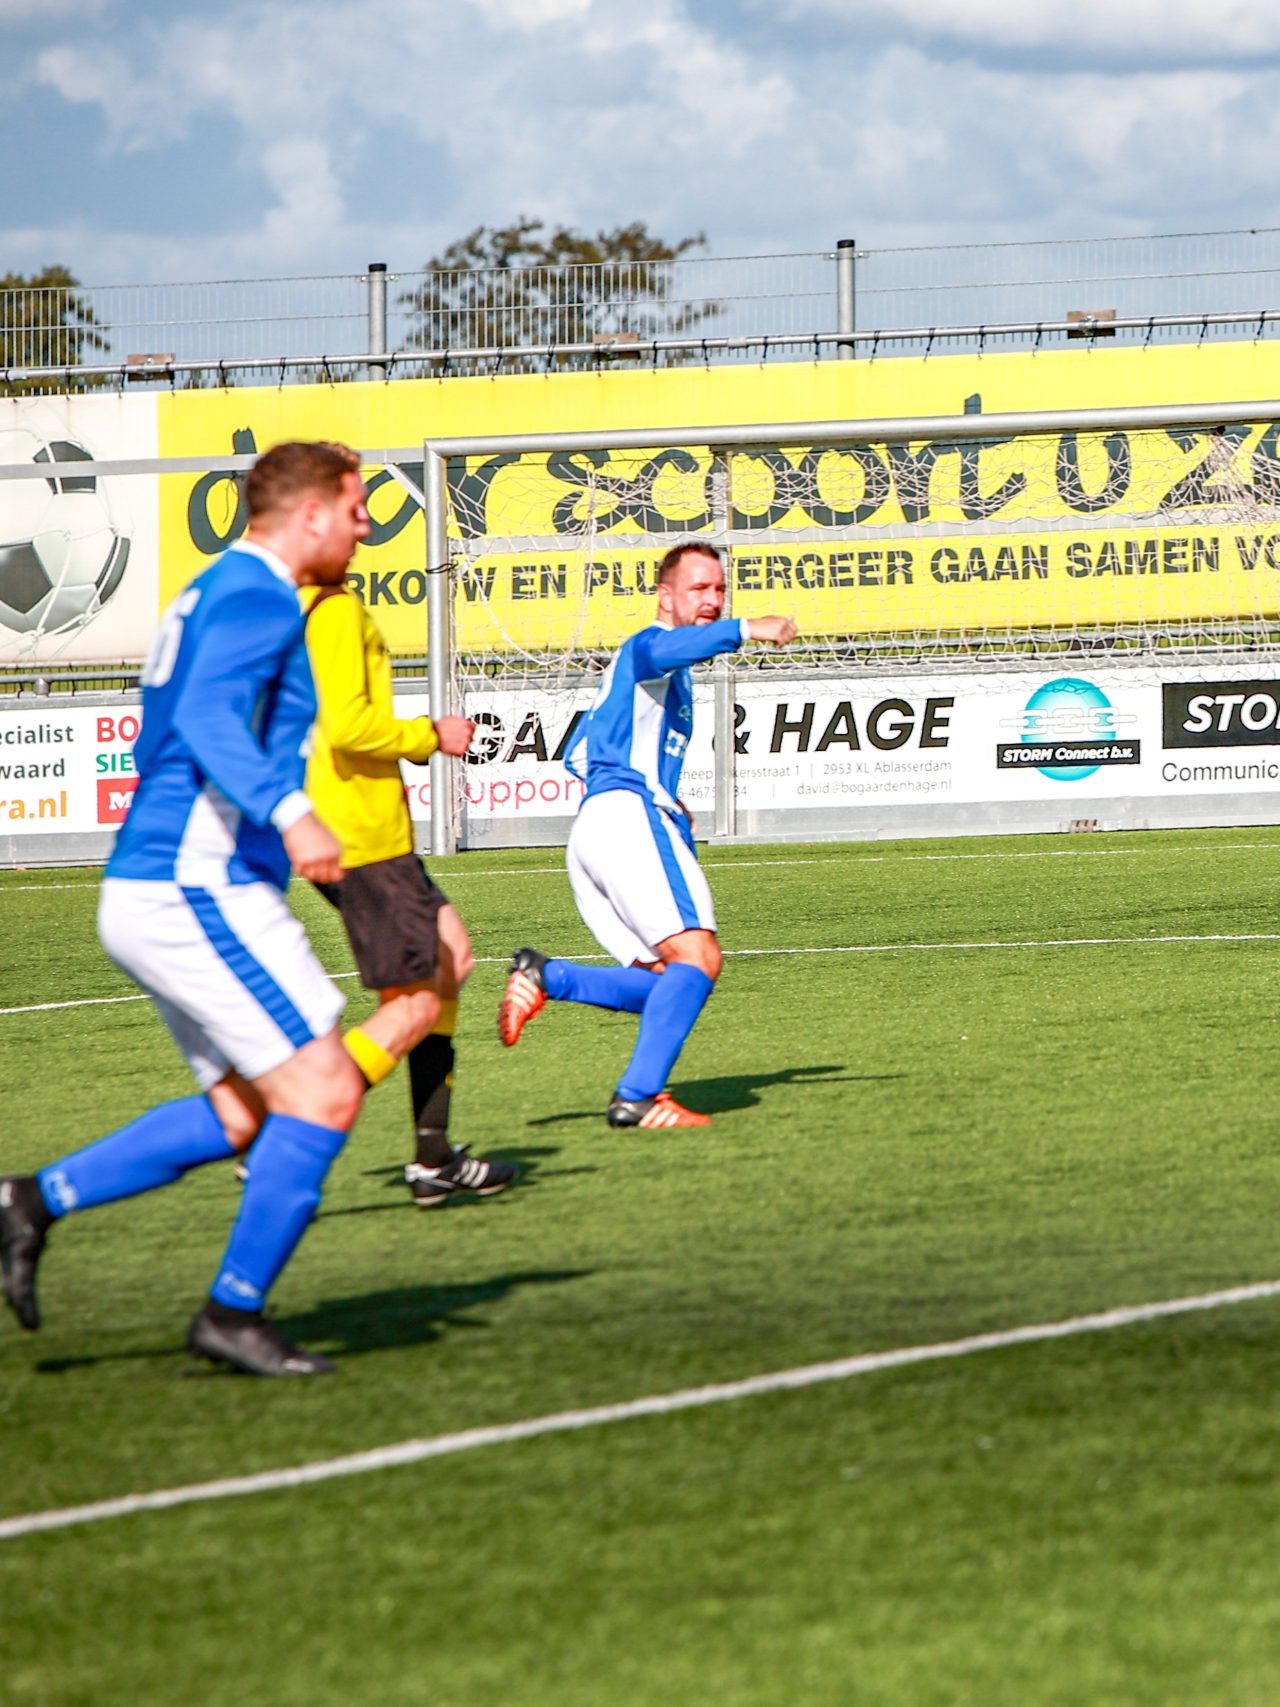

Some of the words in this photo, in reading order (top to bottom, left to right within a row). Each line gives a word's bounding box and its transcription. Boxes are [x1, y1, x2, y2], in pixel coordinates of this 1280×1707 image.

[346, 567, 496, 606] RKOW
[512, 563, 567, 600] EN
[583, 560, 660, 598] PLU
[733, 550, 914, 591] ERGEER
[931, 545, 1048, 583] GAAN
[1065, 536, 1219, 579] SAMEN
[0, 724, 74, 745] cialist
[769, 697, 955, 754] HAGE
[1002, 748, 1053, 763] STORM
[1055, 746, 1110, 761] Connect
[1110, 745, 1134, 760] b.v.
[823, 763, 853, 776] 2953
[855, 762, 871, 775] XL
[874, 759, 953, 774] Ablasserdam
[797, 779, 953, 797] david@bogaardenhage.nl
